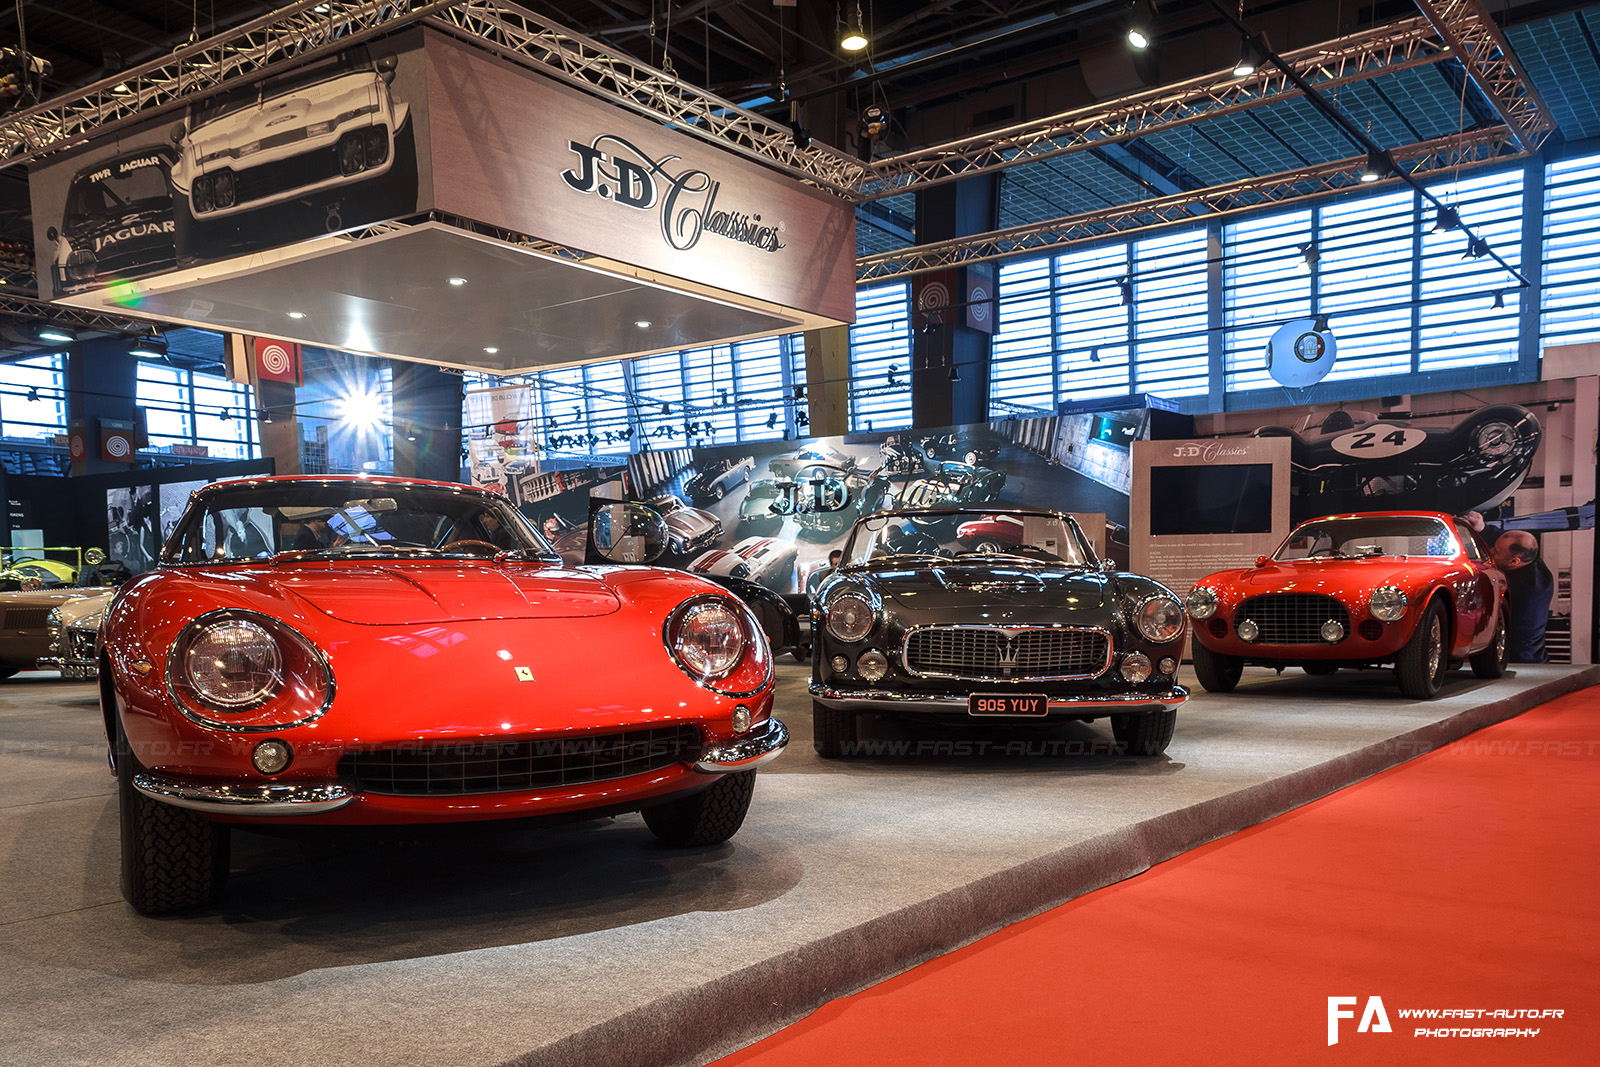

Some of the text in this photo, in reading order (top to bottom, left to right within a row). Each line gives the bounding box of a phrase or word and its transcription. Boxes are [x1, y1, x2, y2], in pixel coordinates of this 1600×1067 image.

[89, 156, 160, 183] TWR JAGUAR
[660, 157, 786, 252] Classics
[94, 220, 176, 253] JAGUAR
[1350, 430, 1407, 450] 24
[1202, 442, 1248, 463] Classics
[977, 699, 1039, 712] 905 YUY
